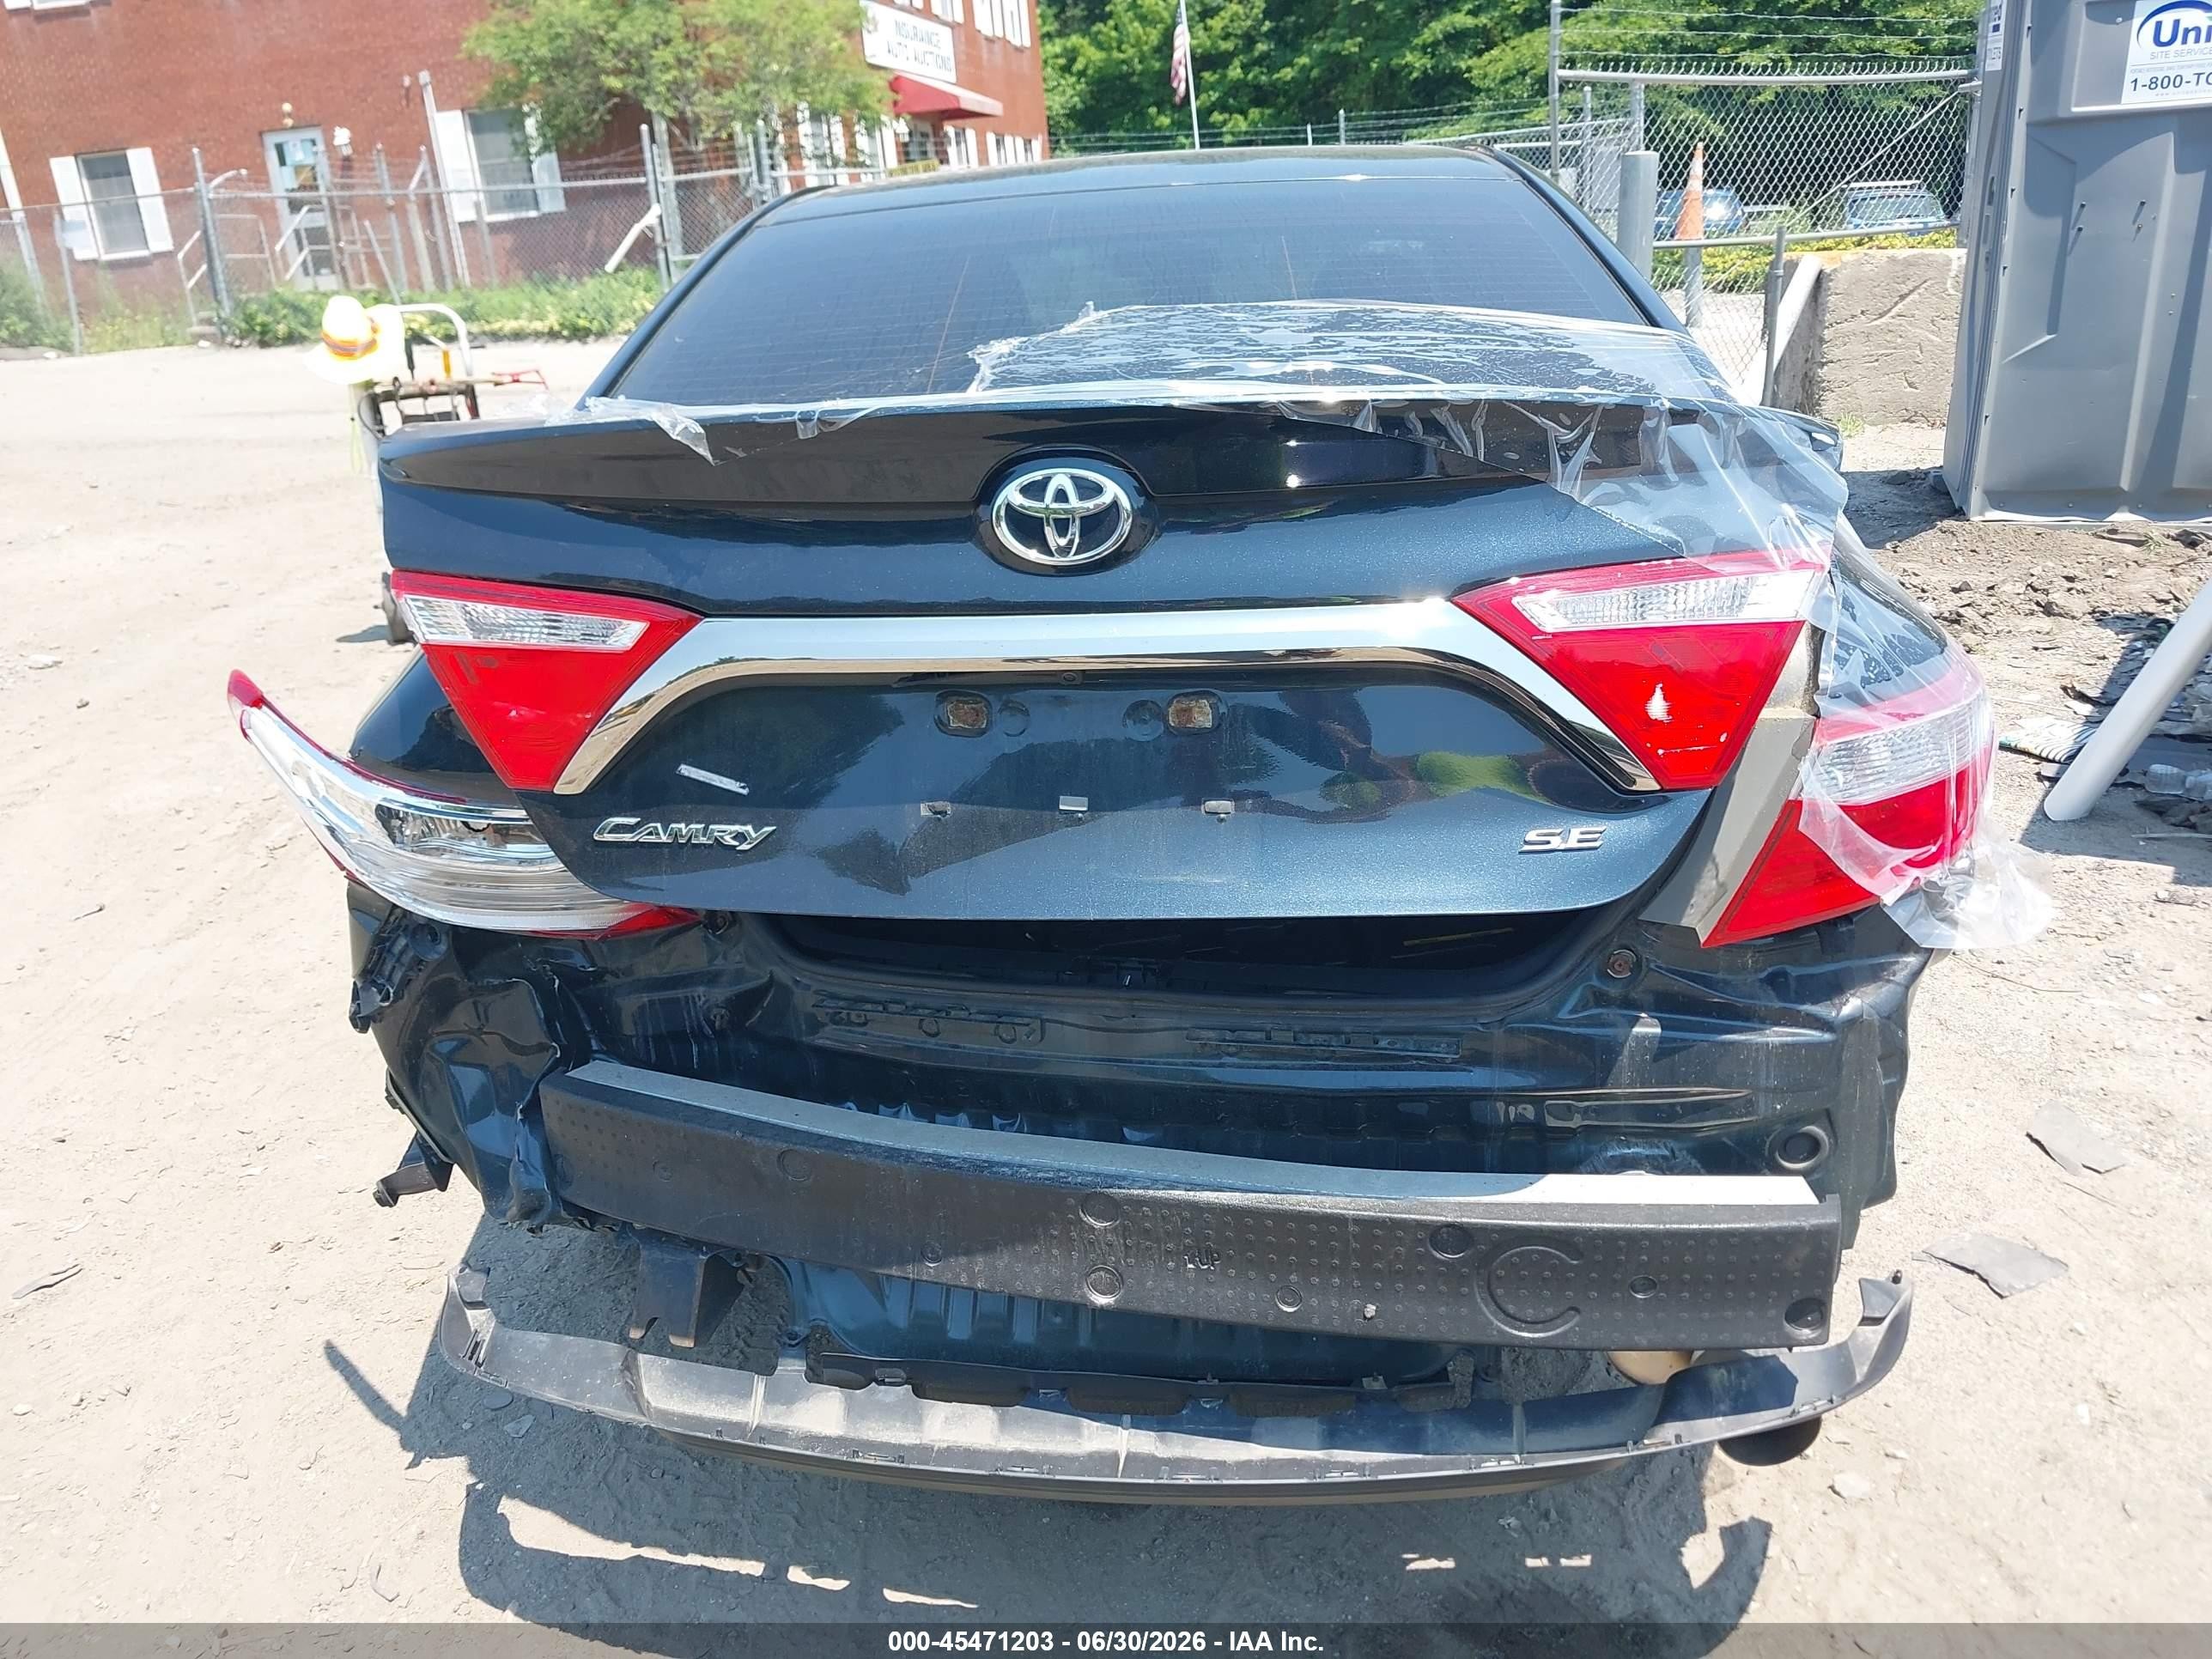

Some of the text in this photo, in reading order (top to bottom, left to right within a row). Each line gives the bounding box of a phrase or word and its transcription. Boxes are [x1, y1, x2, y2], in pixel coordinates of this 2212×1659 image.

[2149, 51, 2171, 60] SITE
[592, 817, 777, 851] CAMRY
[1517, 825, 1607, 854] SE
